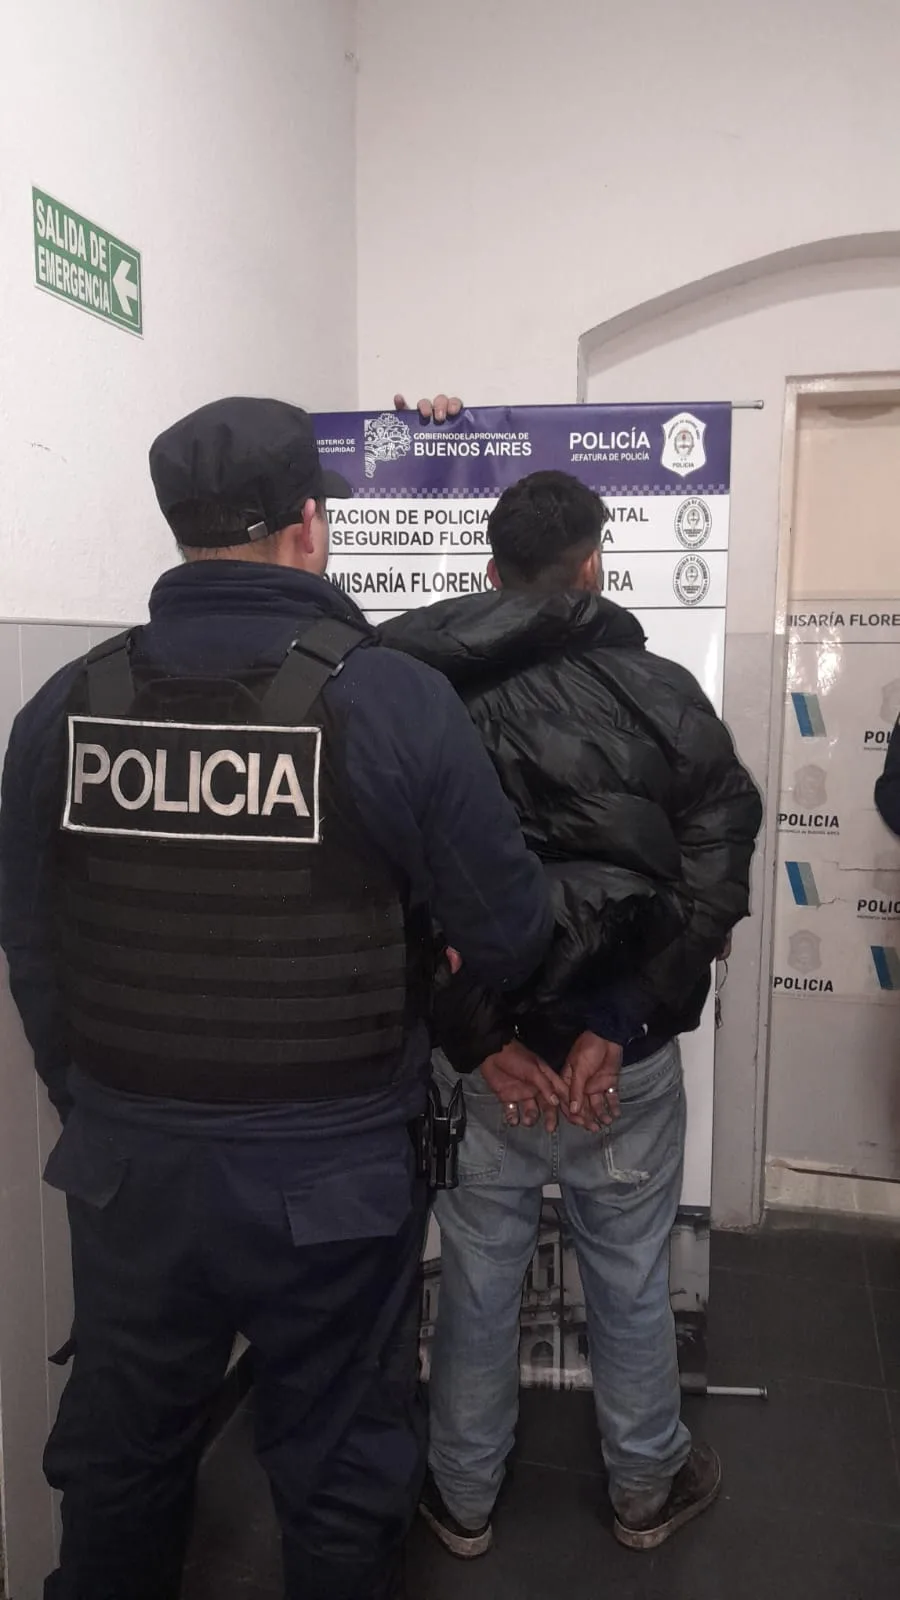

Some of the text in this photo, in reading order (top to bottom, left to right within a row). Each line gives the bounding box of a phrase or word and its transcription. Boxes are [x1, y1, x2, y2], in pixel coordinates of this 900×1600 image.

[36, 198, 107, 272] SALIDA DE
[38, 245, 111, 314] EMERGENCIA
[518, 432, 529, 440] DE
[569, 427, 651, 450] POLICÍA
[414, 442, 532, 456] BUENOS AIRES
[571, 453, 607, 462] JEFATURA
[609, 453, 619, 461] DE
[396, 509, 419, 524] DE
[332, 530, 434, 546] SEGURIDAD
[74, 742, 311, 817] POLICIA
[778, 813, 840, 828] POLICIA
[773, 976, 834, 992] POLICIA
